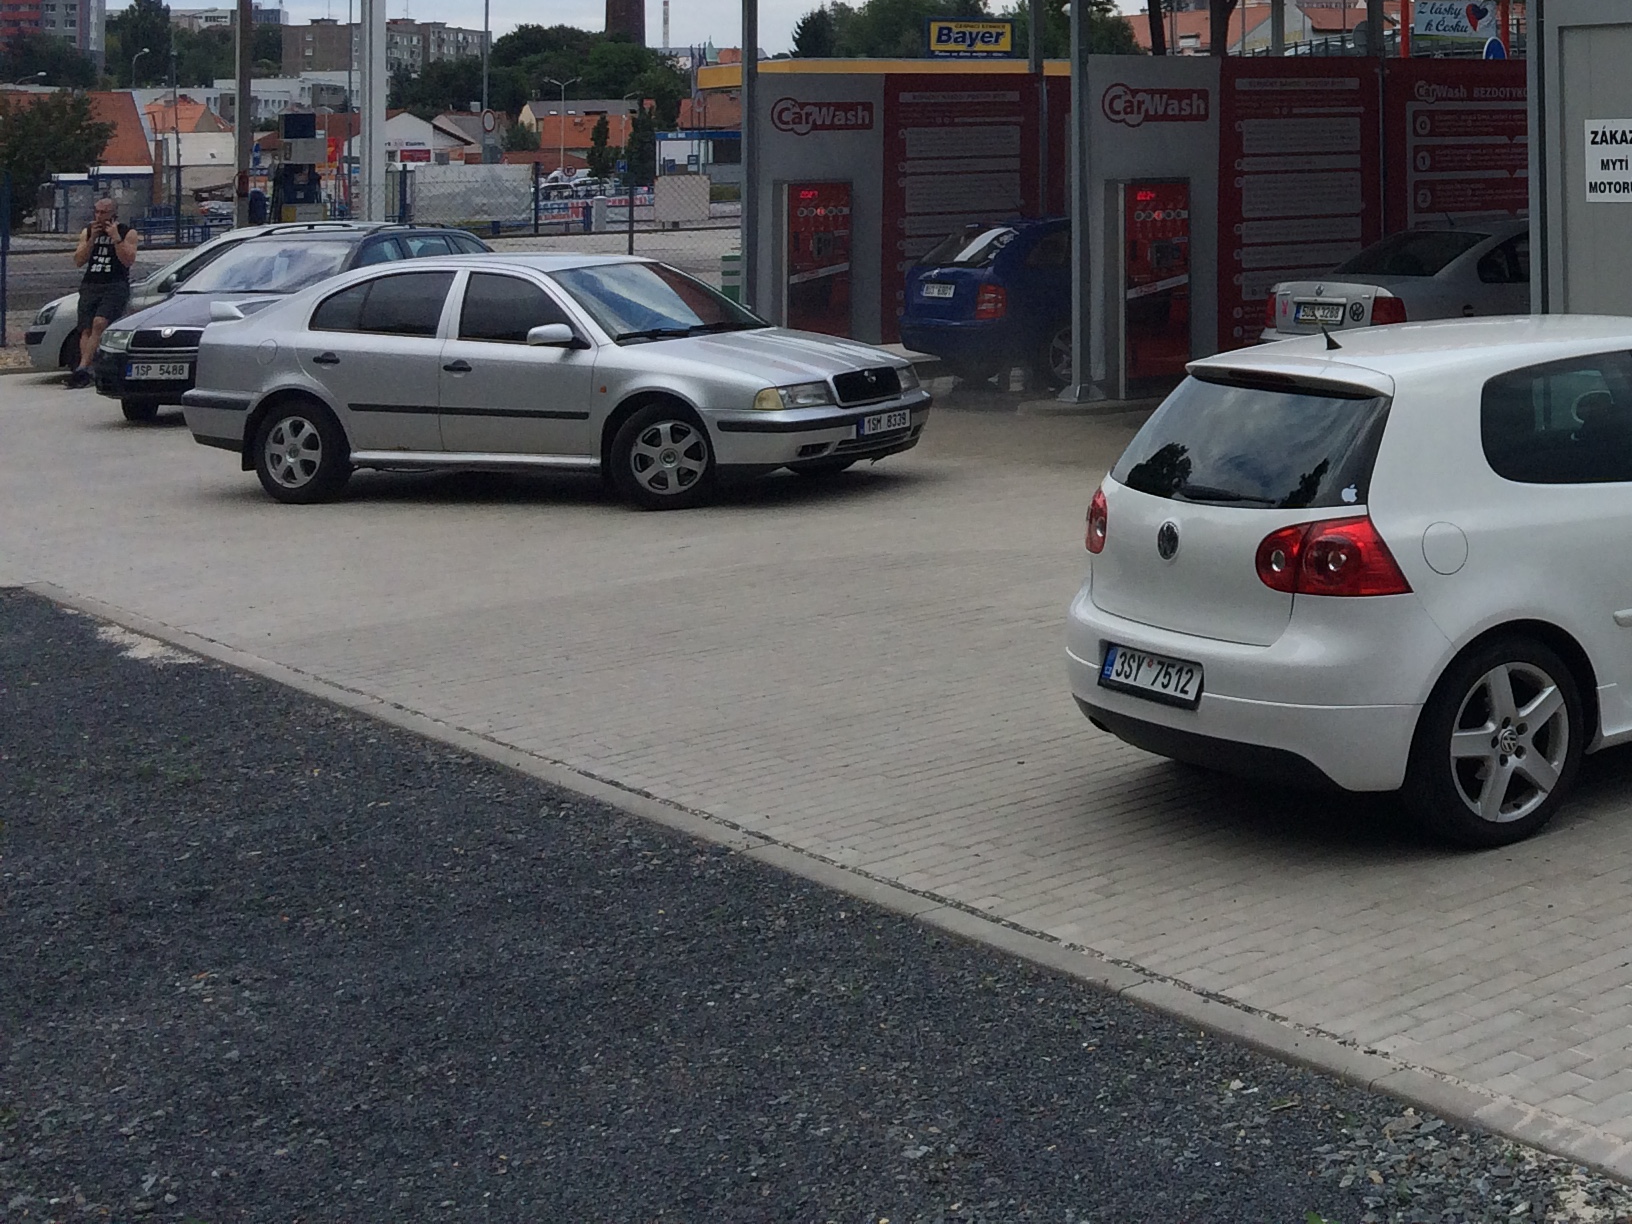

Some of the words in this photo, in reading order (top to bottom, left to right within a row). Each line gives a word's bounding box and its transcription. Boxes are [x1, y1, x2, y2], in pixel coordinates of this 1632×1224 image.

[1417, 2, 1427, 14] Z
[1430, 1, 1462, 18] lásky
[936, 26, 1006, 48] Bayer
[1108, 92, 1206, 115] CarWash
[778, 106, 870, 126] CarWash
[1600, 155, 1629, 171] MYTÍ
[134, 365, 152, 376] 1SP
[158, 364, 185, 376] 5488
[1115, 651, 1147, 683] 3SY
[1150, 662, 1195, 695] 7512
